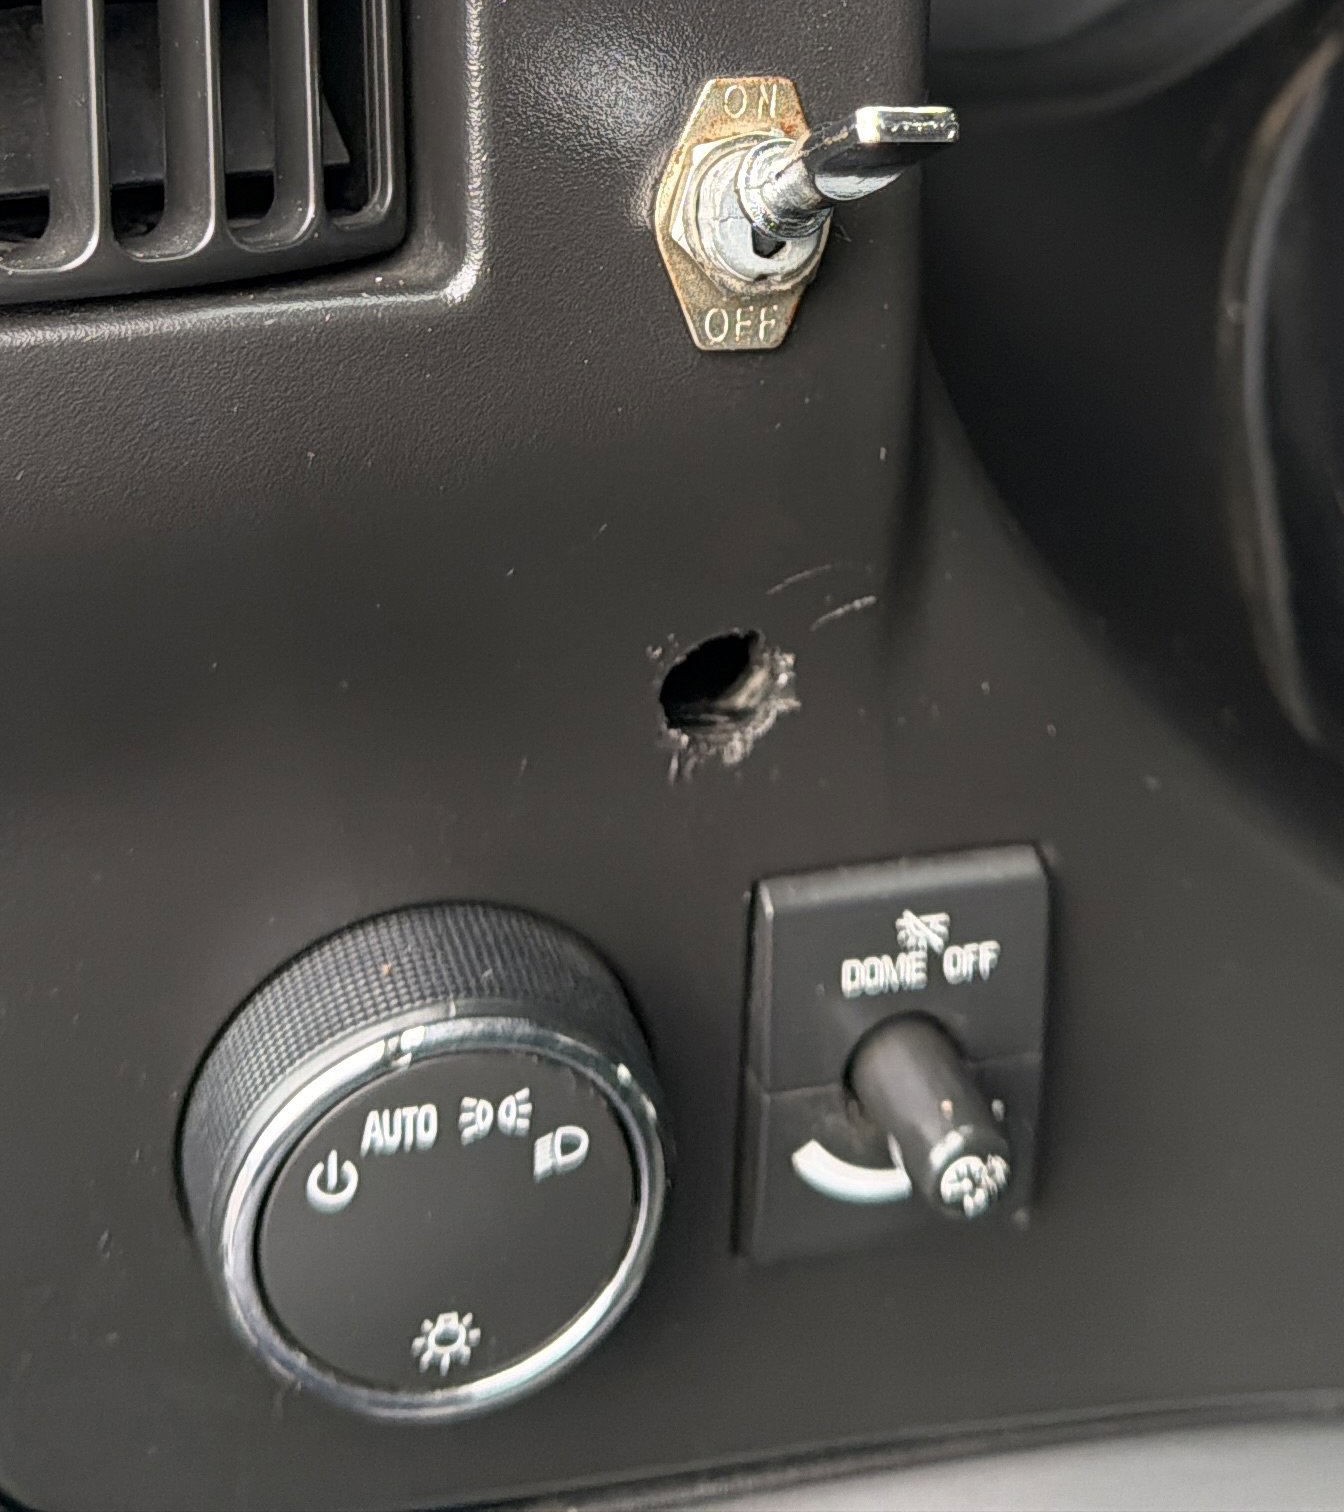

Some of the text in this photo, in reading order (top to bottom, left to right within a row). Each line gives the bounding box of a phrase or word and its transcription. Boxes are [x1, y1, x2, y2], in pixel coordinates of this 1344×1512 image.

[723, 83, 778, 119] ON
[704, 305, 778, 343] OFF
[841, 940, 1001, 998] DOME OFF
[360, 1103, 437, 1157] AUTO
